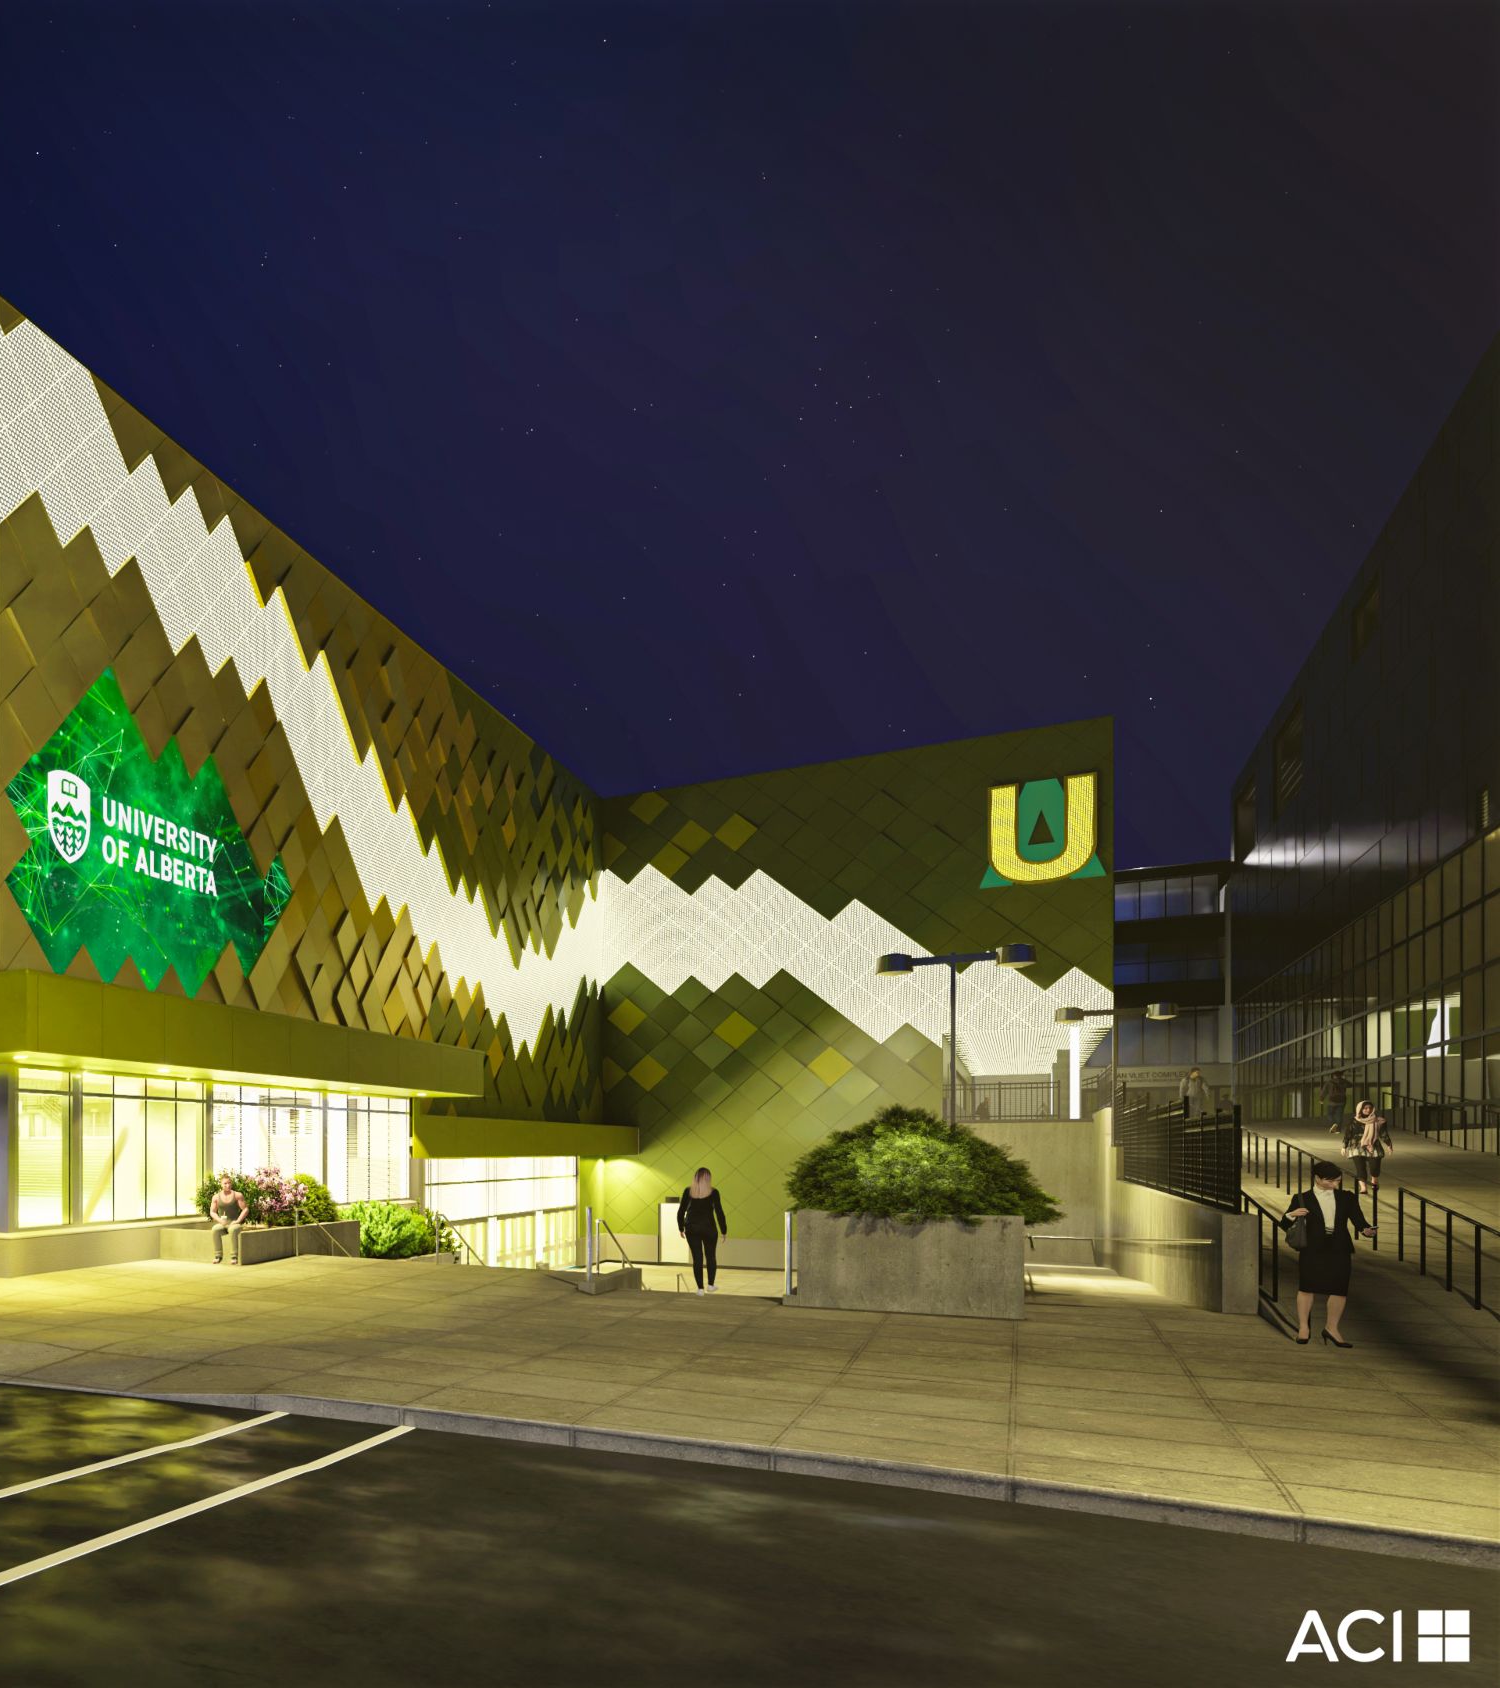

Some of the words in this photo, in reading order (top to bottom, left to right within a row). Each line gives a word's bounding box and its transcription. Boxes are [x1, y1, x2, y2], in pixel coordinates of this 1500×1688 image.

[102, 796, 218, 863] UNIVERSITY
[102, 835, 130, 867] OF
[135, 846, 218, 897] ALBERTA
